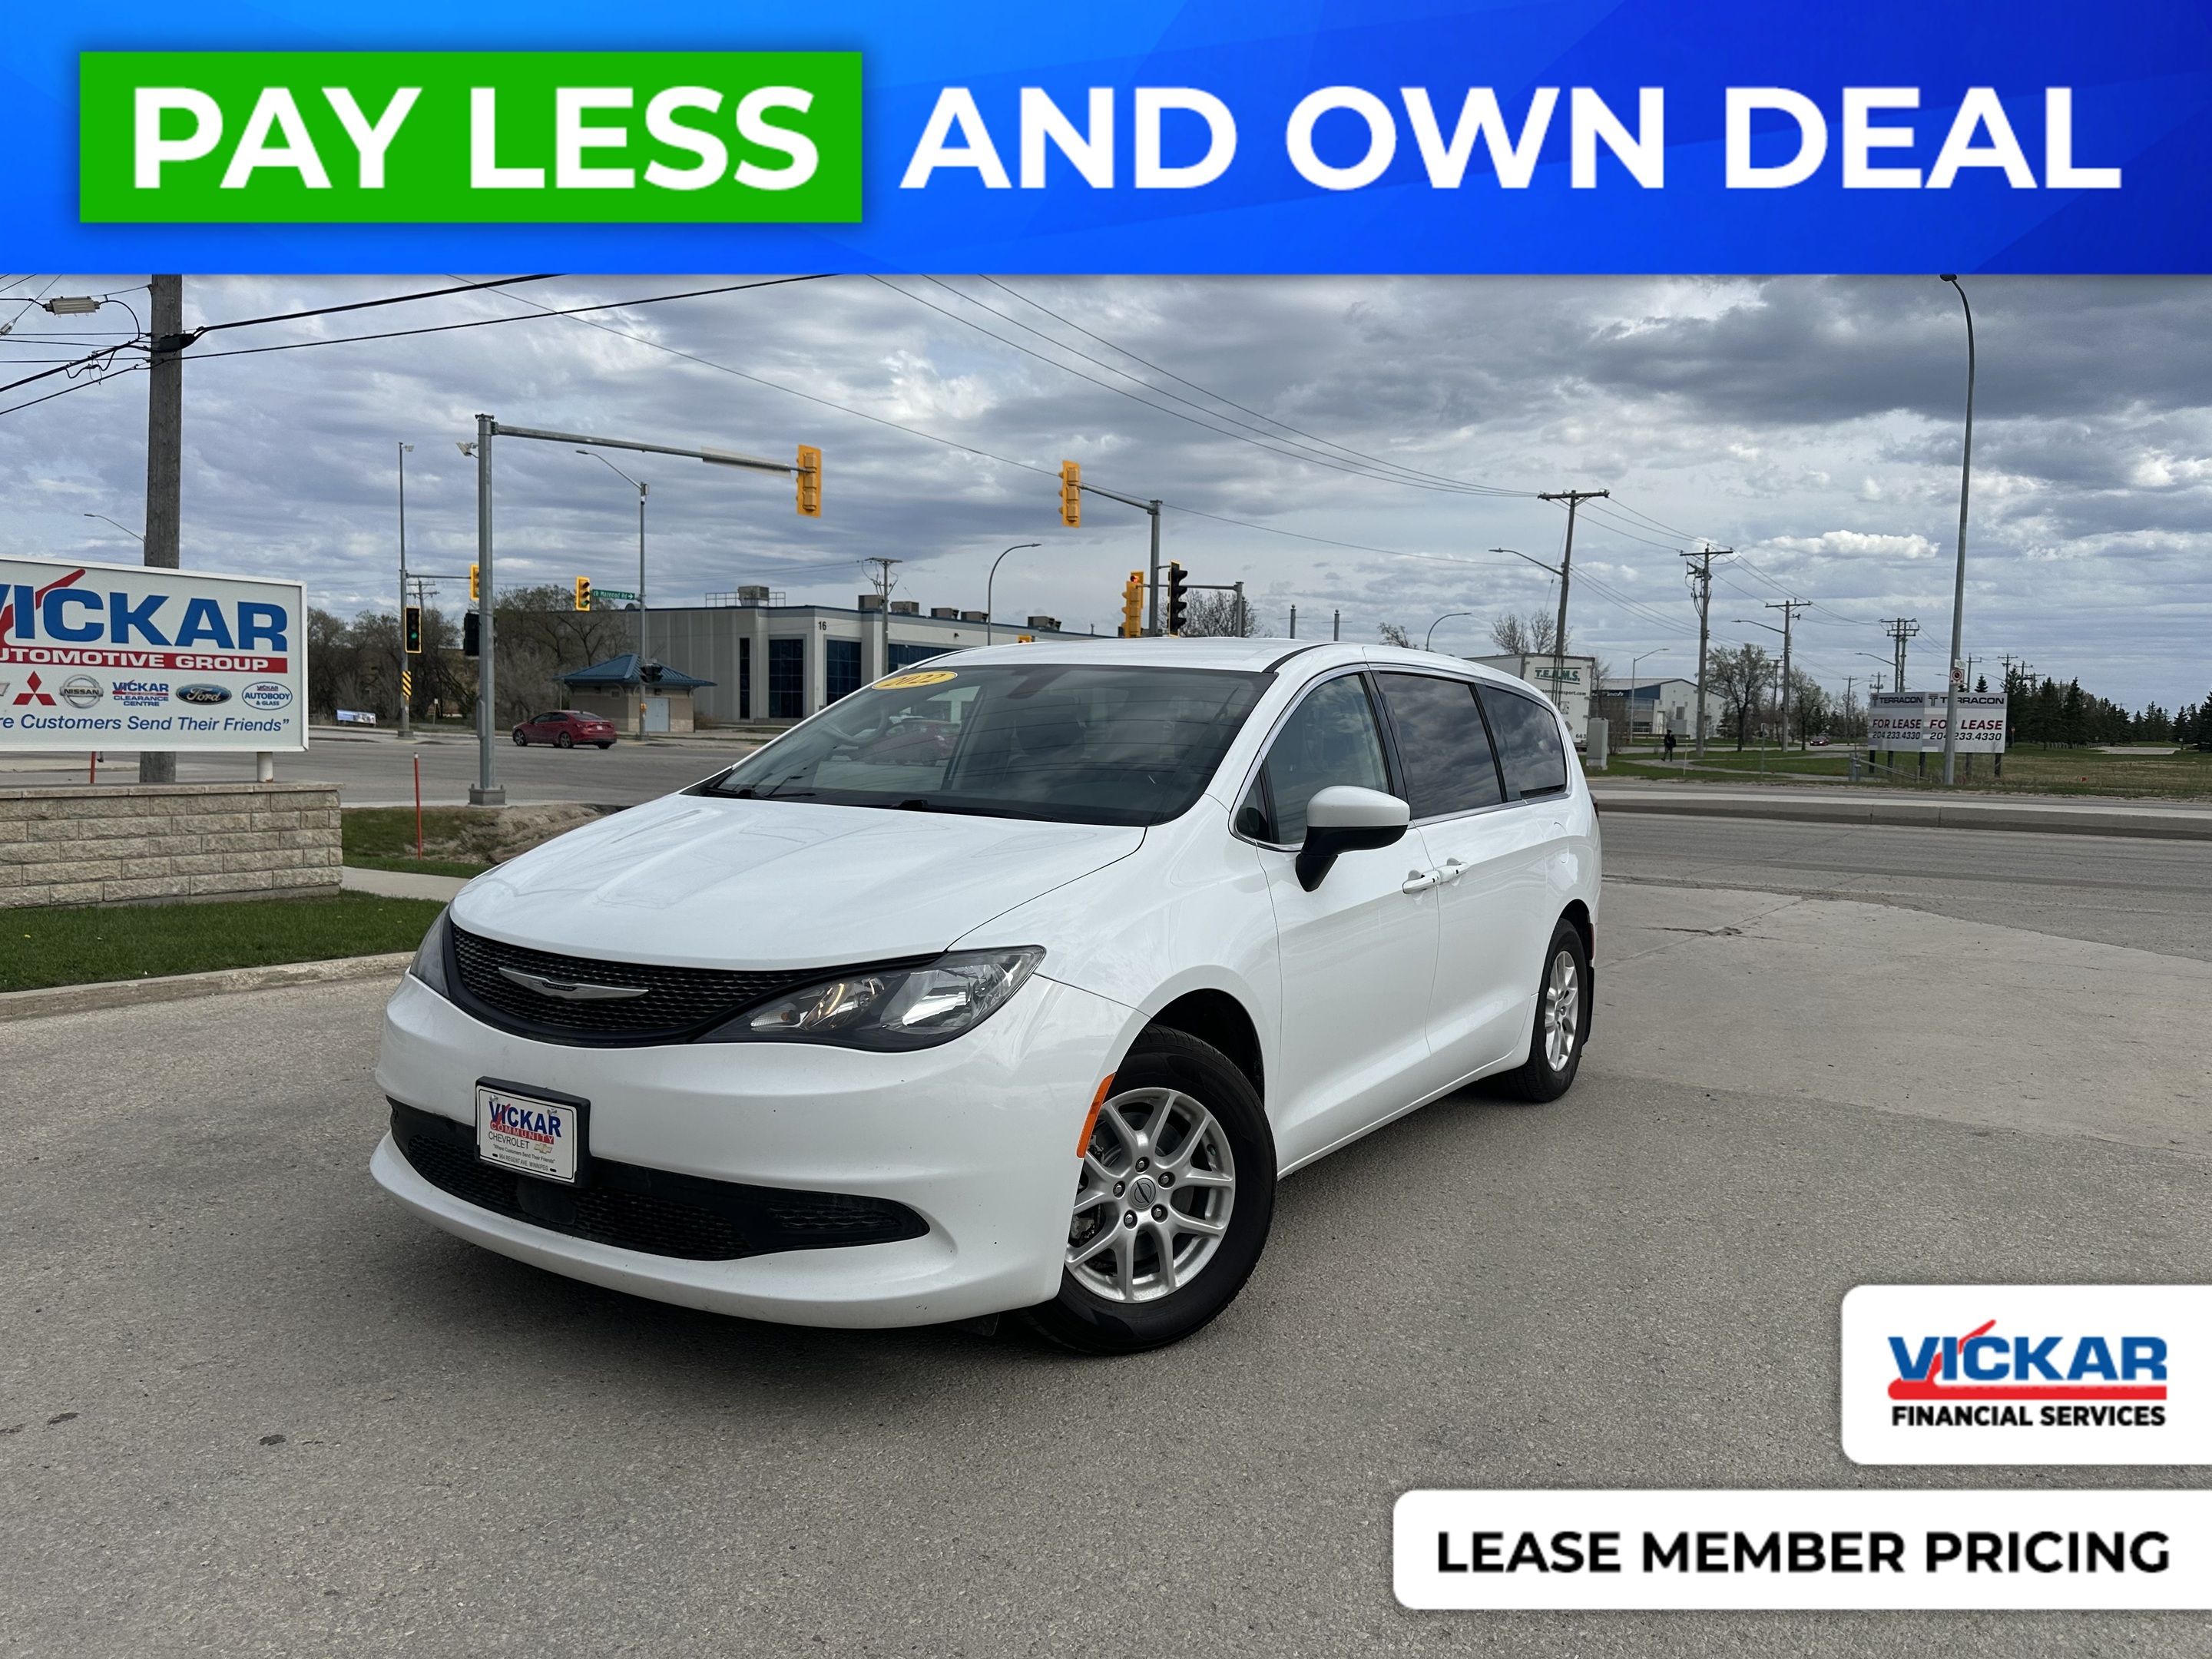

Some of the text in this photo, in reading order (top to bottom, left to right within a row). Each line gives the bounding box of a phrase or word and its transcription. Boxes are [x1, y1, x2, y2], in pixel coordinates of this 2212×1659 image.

[818, 621, 827, 631] 16
[175, 655, 269, 671] GROUP
[880, 673, 947, 687] 2022
[112, 681, 169, 692] VICKAR
[186, 687, 221, 702] Ford
[244, 692, 290, 700] AUTOBODY
[21, 714, 121, 730] Customers
[127, 716, 173, 730] Send
[178, 717, 220, 731] Their
[1873, 719, 1922, 729] FOR LEASE
[1961, 720, 2003, 730] LEASE
[1873, 731, 1920, 740] 204.233.4330
[1929, 732, 2002, 741] 20233.4330
[488, 1101, 562, 1137] VICKAR
[491, 1121, 554, 1144] COMMUNITY
[488, 1131, 530, 1150] CHEVROLET
